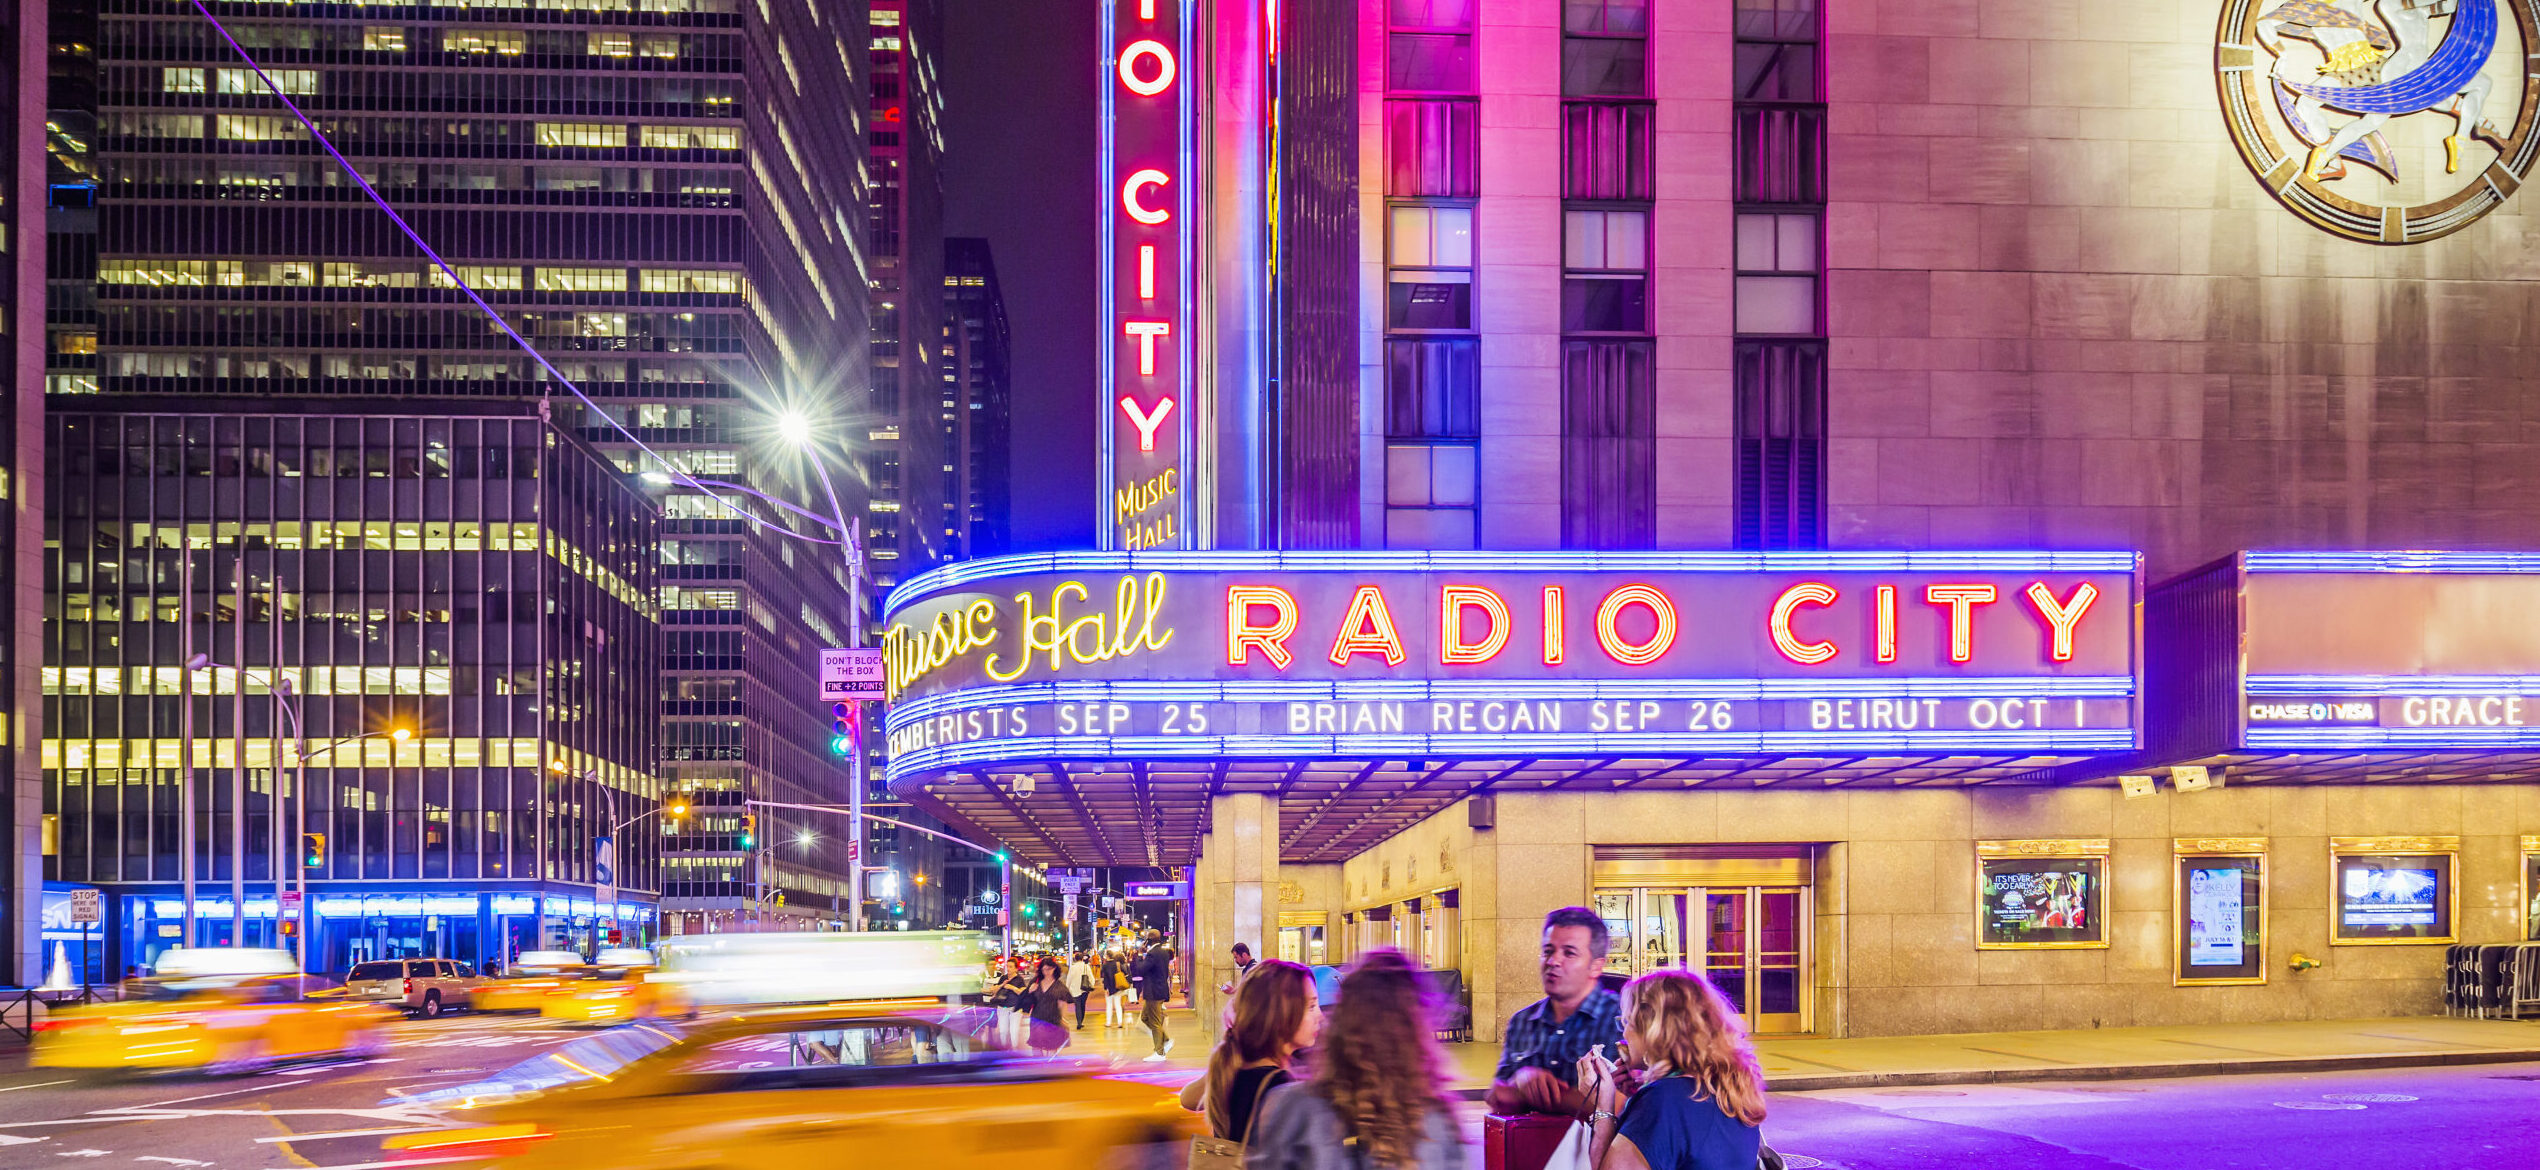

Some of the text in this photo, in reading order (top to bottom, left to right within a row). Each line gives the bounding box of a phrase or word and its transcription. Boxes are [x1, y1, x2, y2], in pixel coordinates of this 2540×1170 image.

[1119, 168, 1176, 452] CITY
[1116, 467, 1176, 525] MUSIC
[1125, 513, 1176, 550] HALL
[1227, 581, 2099, 671] RADIO CITY
[883, 571, 1175, 704] Music Hall
[826, 656, 851, 665] DON'T
[837, 667, 853, 675] THE
[827, 682, 884, 691] FINE +2 POINTS
[1058, 704, 1129, 735] SEP
[1161, 703, 1208, 734] 25
[1289, 702, 1402, 733] BRIAN
[1432, 701, 1562, 732] REGAN
[1590, 701, 1661, 732] SEP
[1689, 700, 1732, 730] 26
[1811, 699, 1941, 730] BEIRUT
[1969, 698, 2048, 729] OCT
[2249, 703, 2374, 720] CHASE VISA
[2403, 697, 2523, 725] GRACE
[2007, 875, 2030, 883] NEVER
[1137, 886, 1169, 896] Subway
[1993, 882, 2009, 890] TOO
[72, 891, 97, 900] STOP
[973, 905, 1003, 915] Hilto
